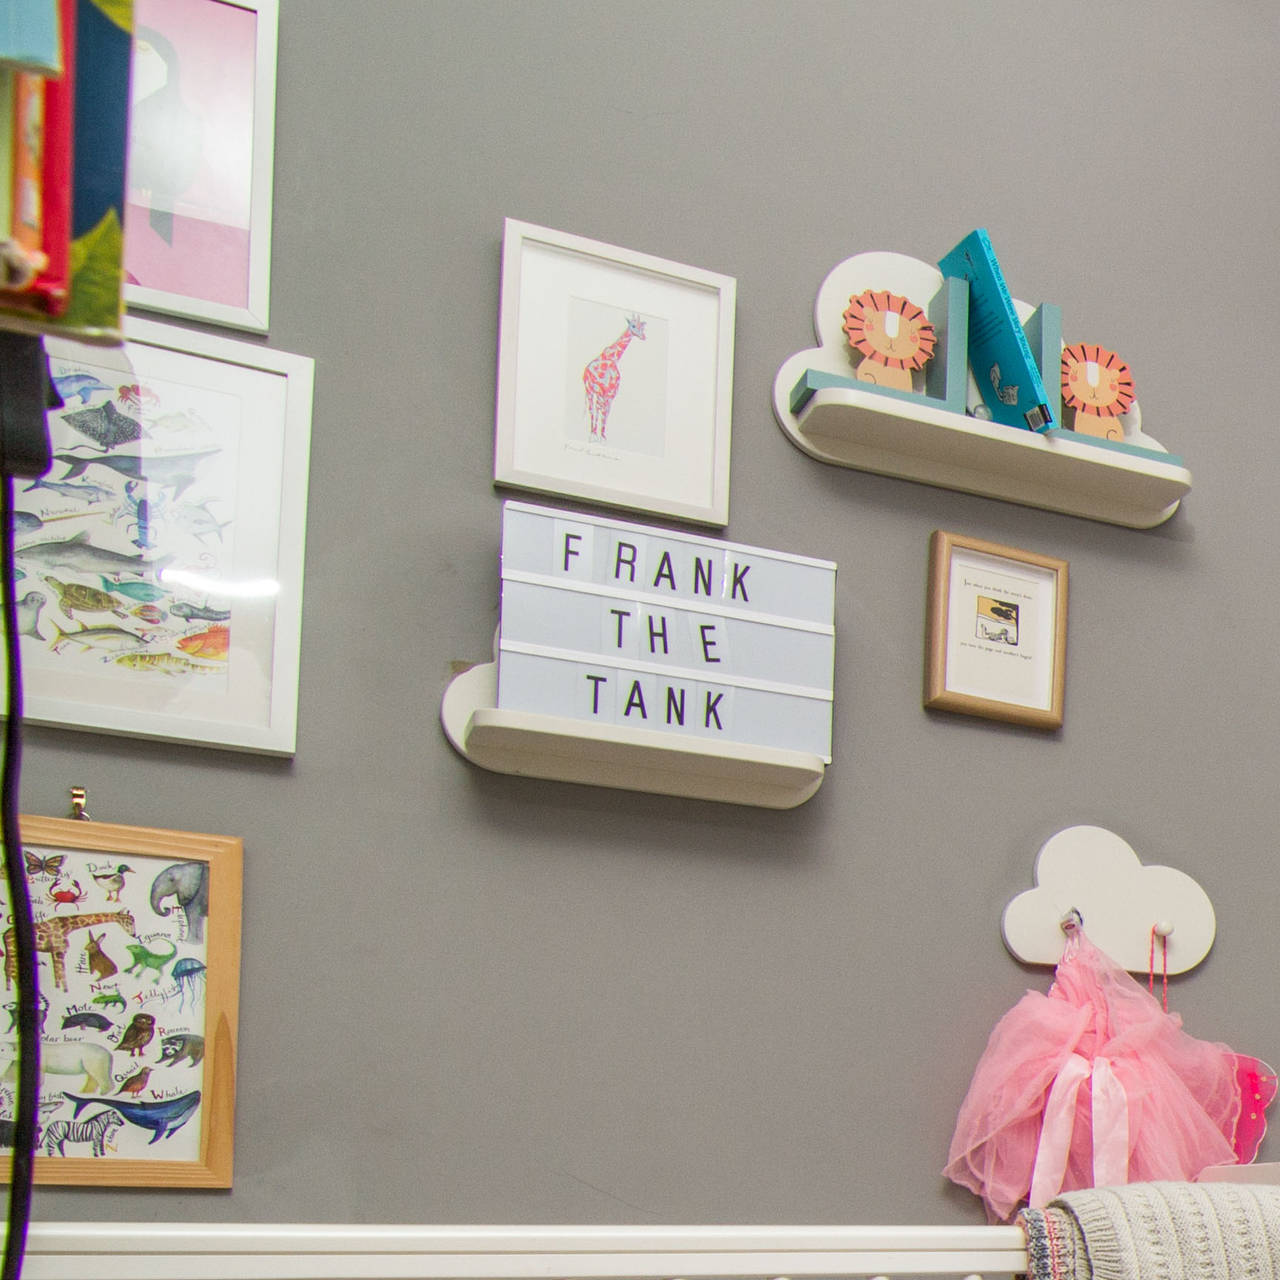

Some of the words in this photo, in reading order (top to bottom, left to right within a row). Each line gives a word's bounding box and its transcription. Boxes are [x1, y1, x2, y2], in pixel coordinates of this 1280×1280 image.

[563, 533, 752, 603] FRANK
[611, 609, 721, 663] THE
[586, 675, 725, 731] TANK
[66, 1003, 96, 1016] Mole
